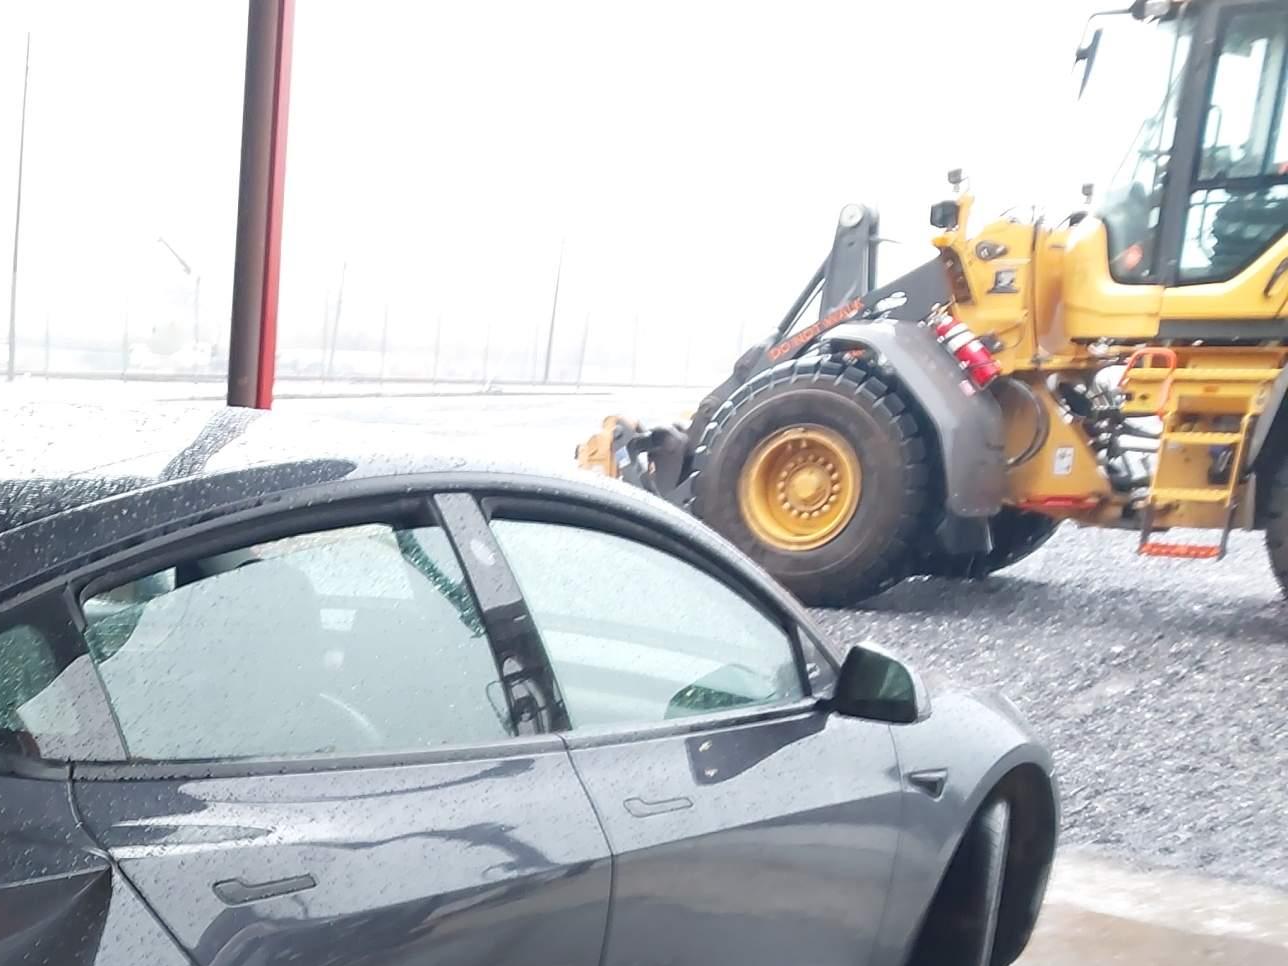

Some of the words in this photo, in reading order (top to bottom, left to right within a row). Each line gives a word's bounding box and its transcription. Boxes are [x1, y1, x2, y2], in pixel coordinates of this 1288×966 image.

[768, 342, 791, 360] DO
[795, 324, 822, 343] NOT
[822, 297, 864, 326] WALK
